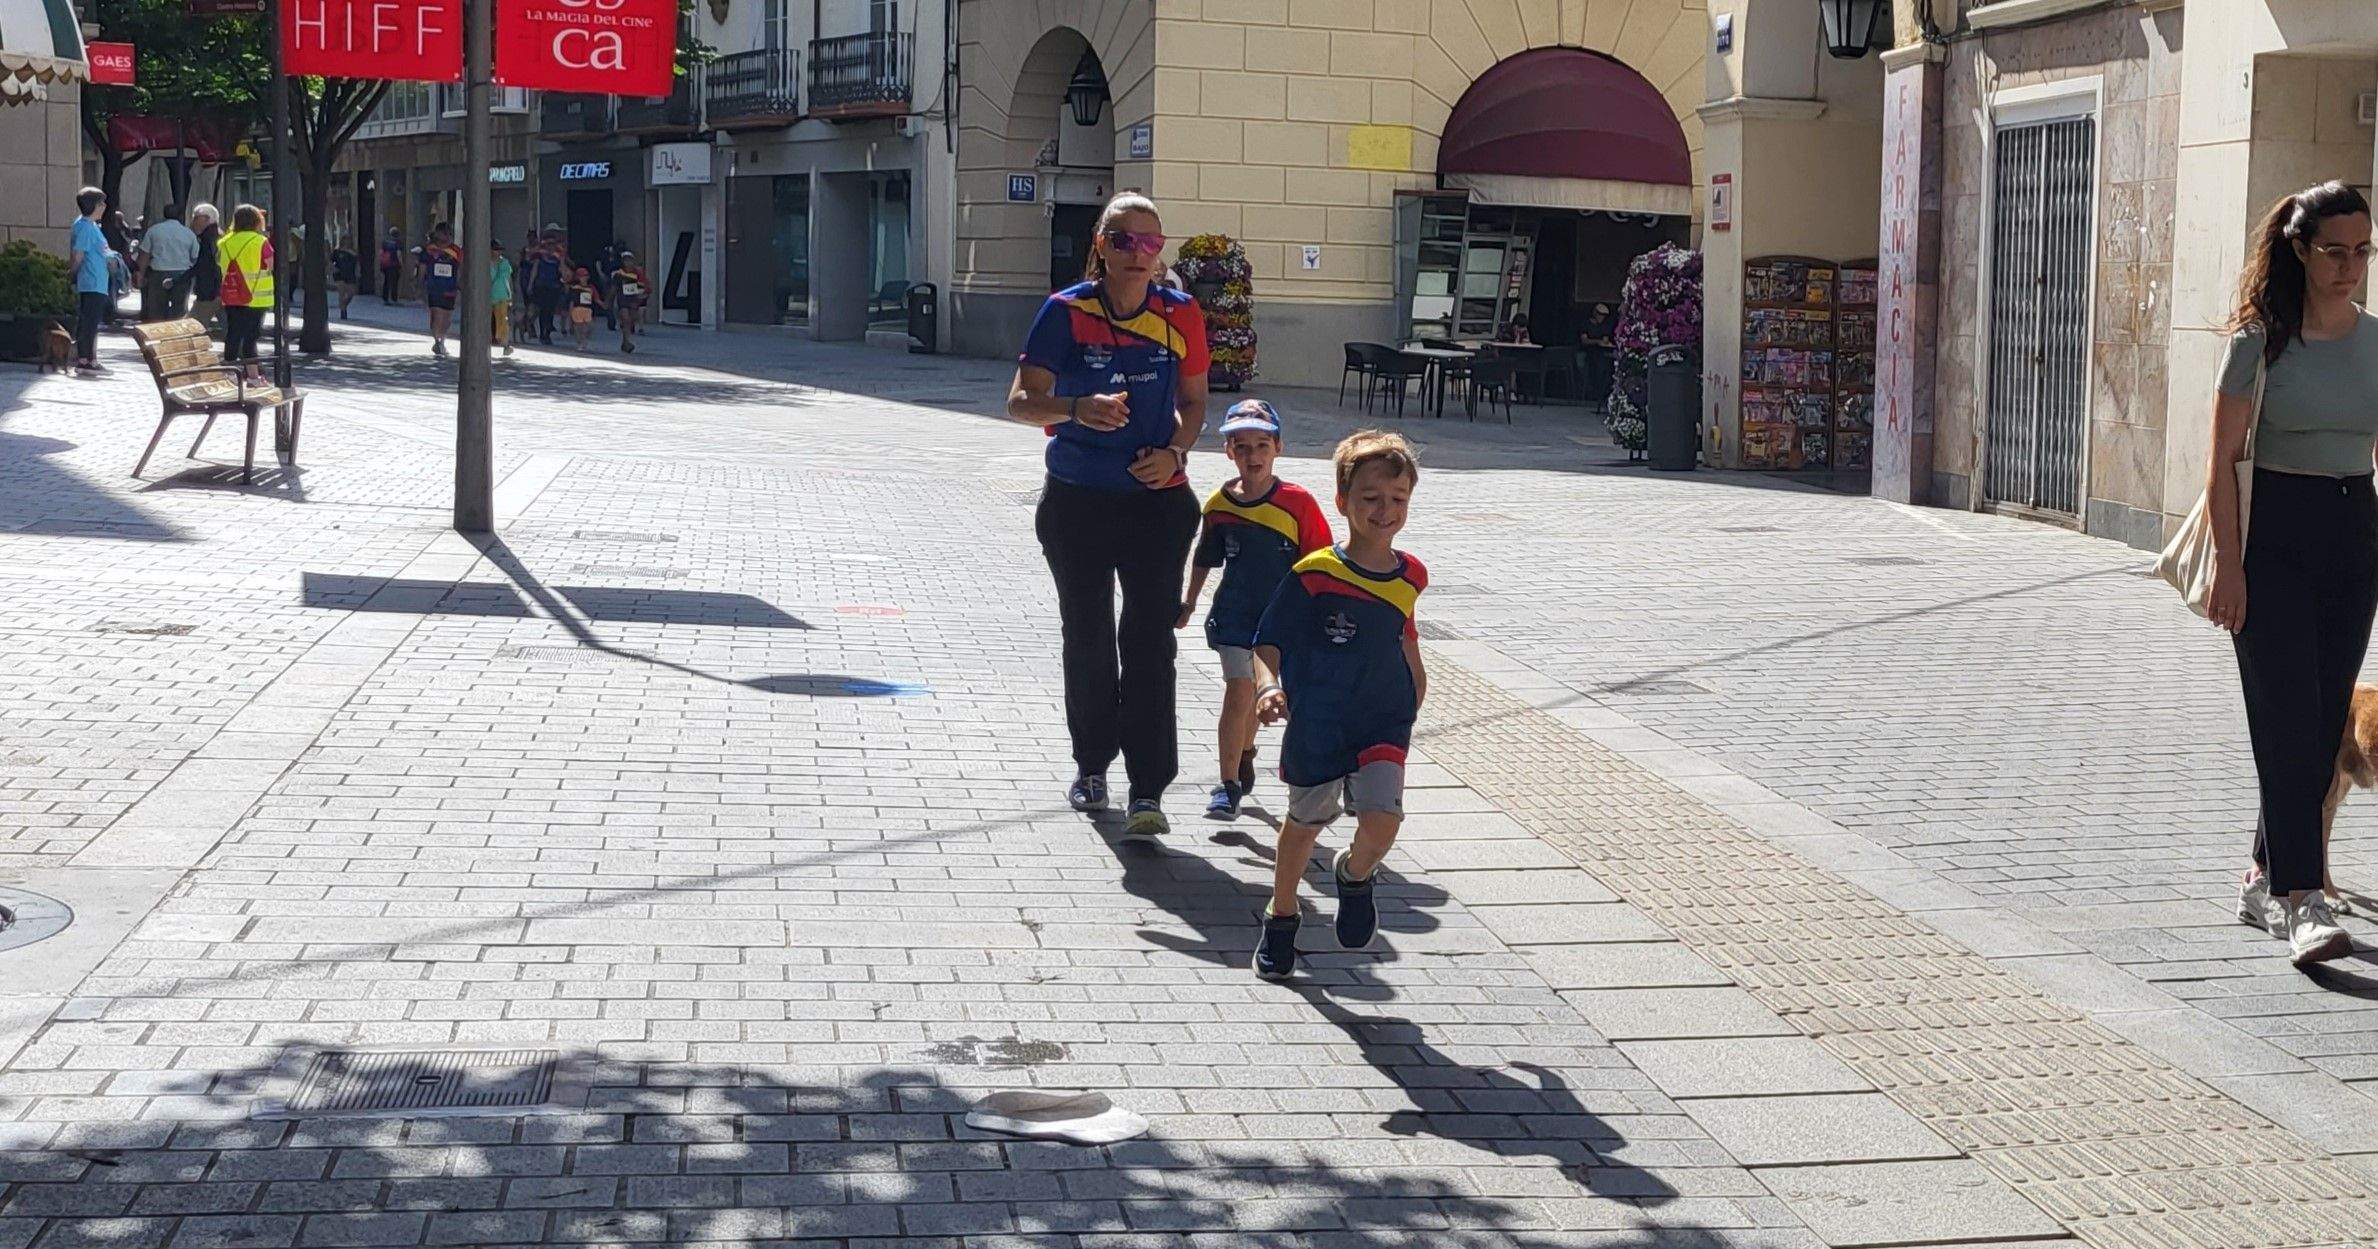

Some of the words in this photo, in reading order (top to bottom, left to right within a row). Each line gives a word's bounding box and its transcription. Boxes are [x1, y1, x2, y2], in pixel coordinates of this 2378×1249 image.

[295, 0, 444, 55] HIFF
[552, 28, 626, 70] ca
[93, 55, 131, 68] GAES
[488, 166, 526, 183] PRINGFIELD
[560, 162, 611, 179] DECIMAS
[1012, 177, 1033, 192] HS
[1887, 83, 1908, 434] FARMACIA
